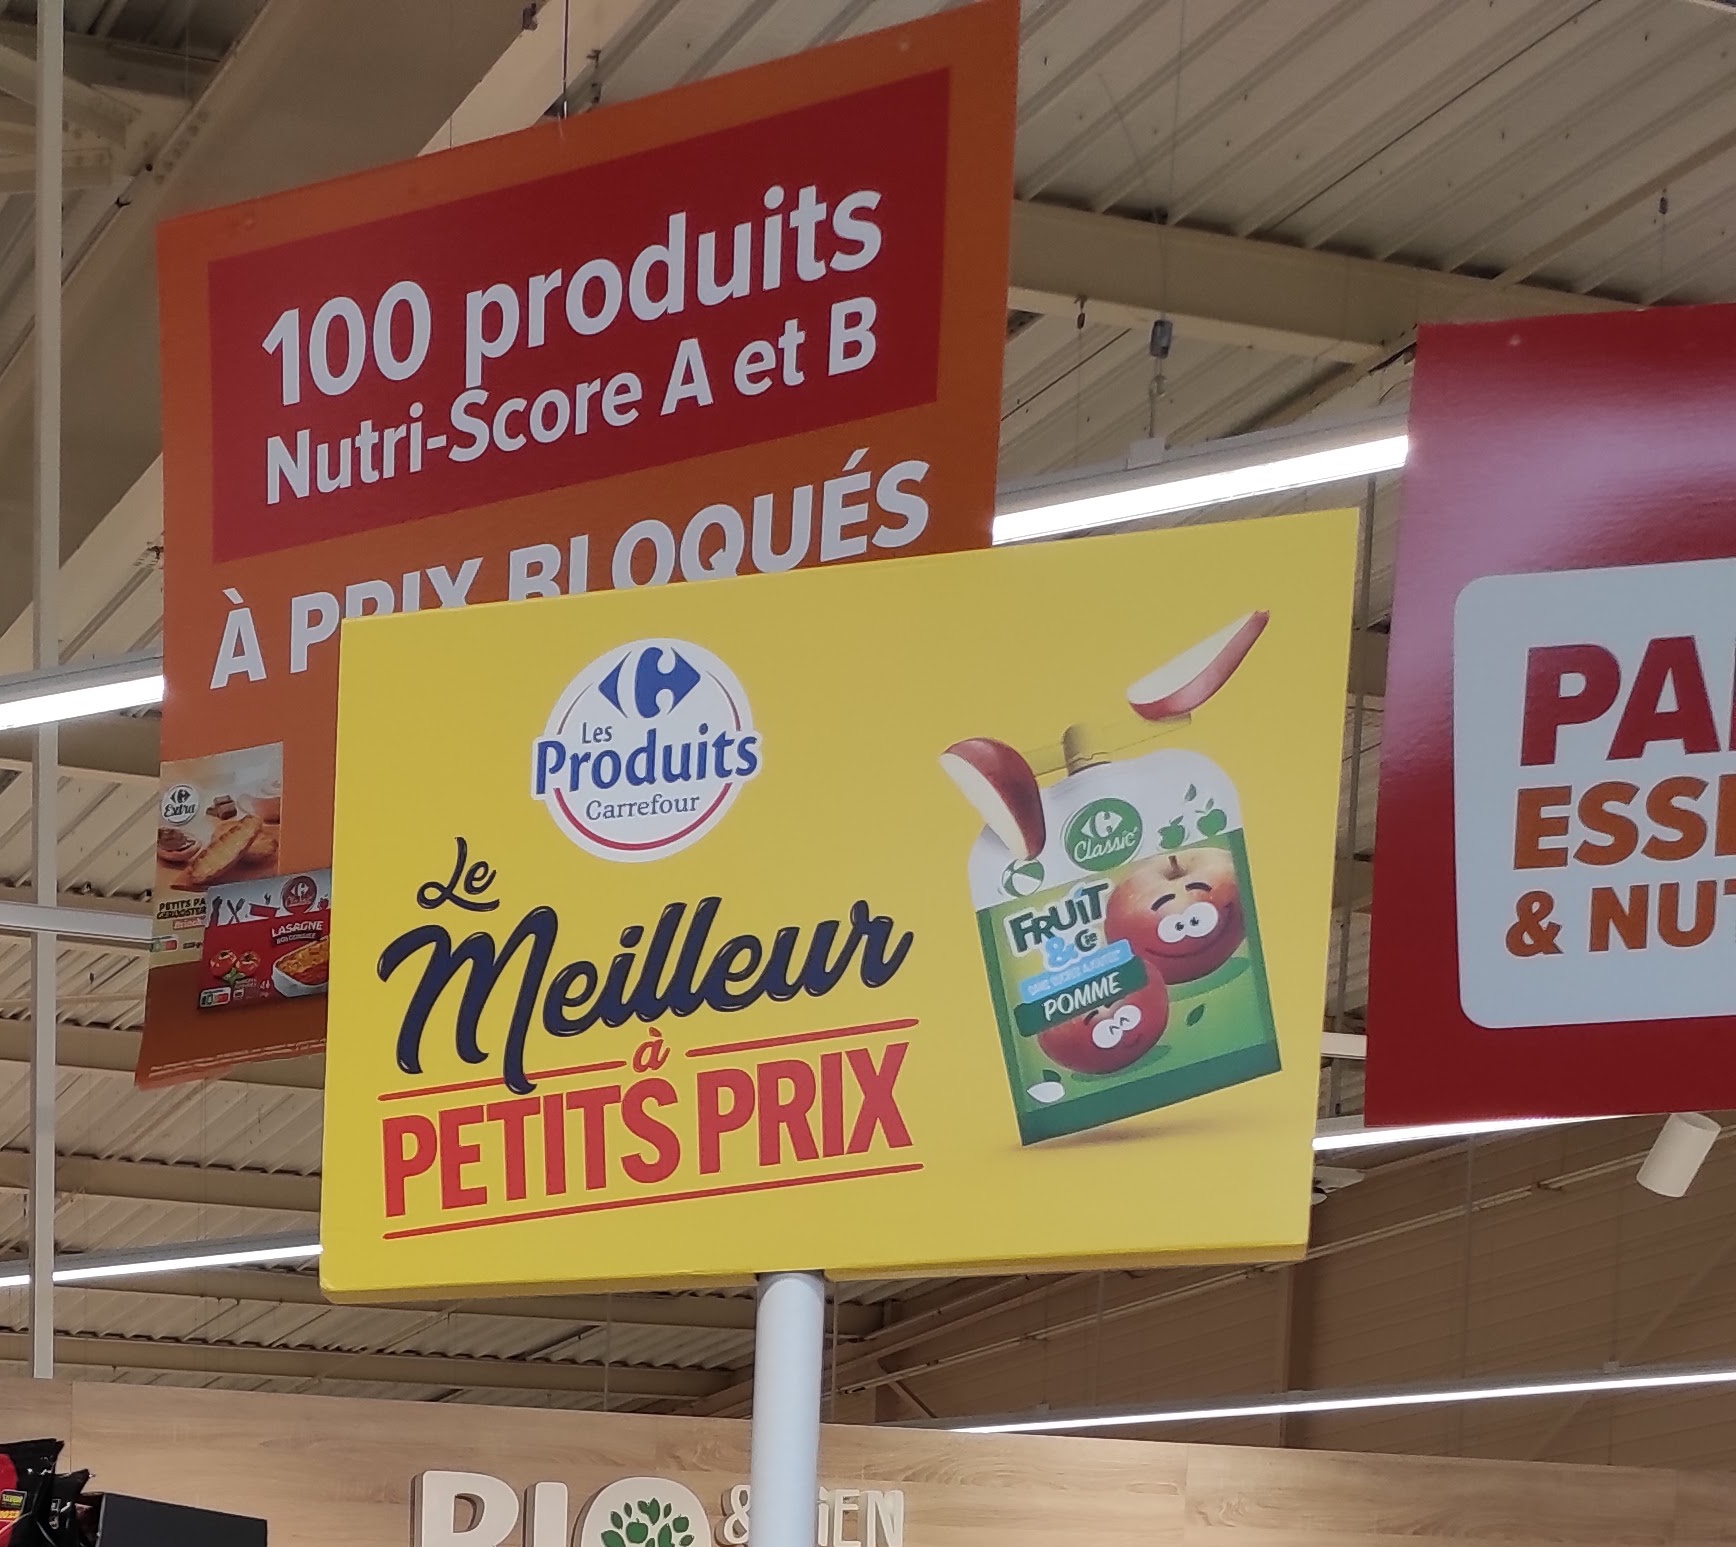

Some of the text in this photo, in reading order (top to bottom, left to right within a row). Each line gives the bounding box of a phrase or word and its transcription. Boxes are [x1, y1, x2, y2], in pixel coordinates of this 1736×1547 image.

[261, 185, 883, 405] 100 produits
[265, 296, 878, 505] Nutri-Score A et B
[209, 587, 268, 690] À
[580, 721, 614, 745] Les
[1520, 635, 1736, 767] PA
[535, 723, 759, 797] Produits
[584, 789, 702, 826] Carrefour
[417, 836, 500, 912] Le
[1505, 890, 1564, 959] &
[376, 897, 915, 1096] Meilleur
[1043, 971, 1124, 1023] POMME
[631, 1026, 669, 1074] à
[382, 1041, 916, 1219] PETITS PRIX
